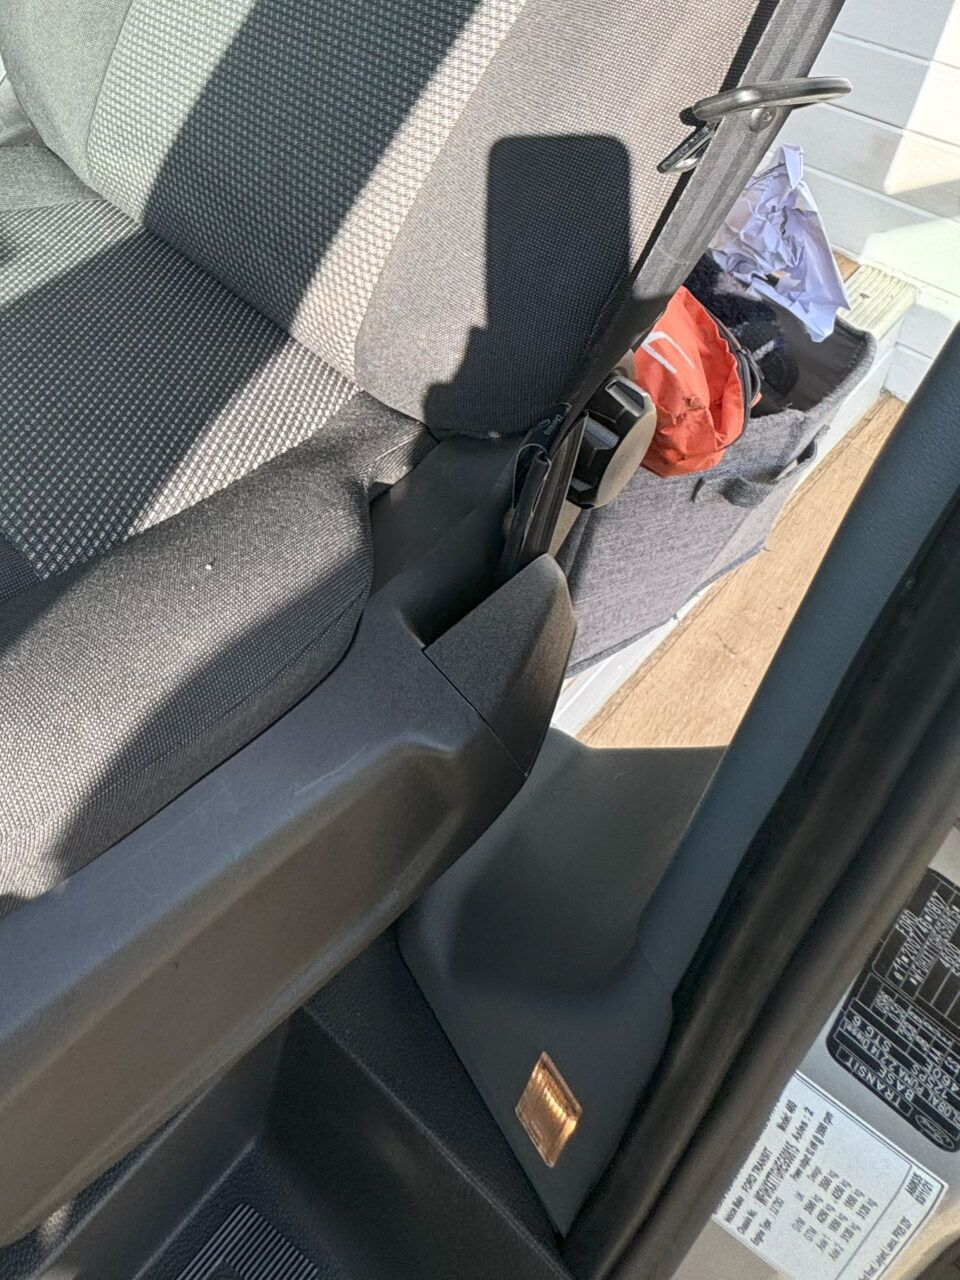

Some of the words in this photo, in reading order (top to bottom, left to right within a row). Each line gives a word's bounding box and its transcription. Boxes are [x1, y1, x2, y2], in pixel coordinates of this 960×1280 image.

[896, 909, 917, 937] FORD
[844, 1020, 870, 1047] Diesel
[852, 1016, 861, 1029] 6
[866, 1028, 892, 1052] STG
[845, 1057, 901, 1109] TRANSIT
[877, 1067, 914, 1101] BASE
[898, 1068, 926, 1094] PUMA
[910, 1064, 948, 1098] 125PS
[924, 1062, 960, 1091] 460E
[792, 1121, 808, 1142] Axles
[804, 1107, 813, 1116] 2
[742, 1174, 757, 1192] FORD
[752, 1147, 771, 1175] TRANSIT
